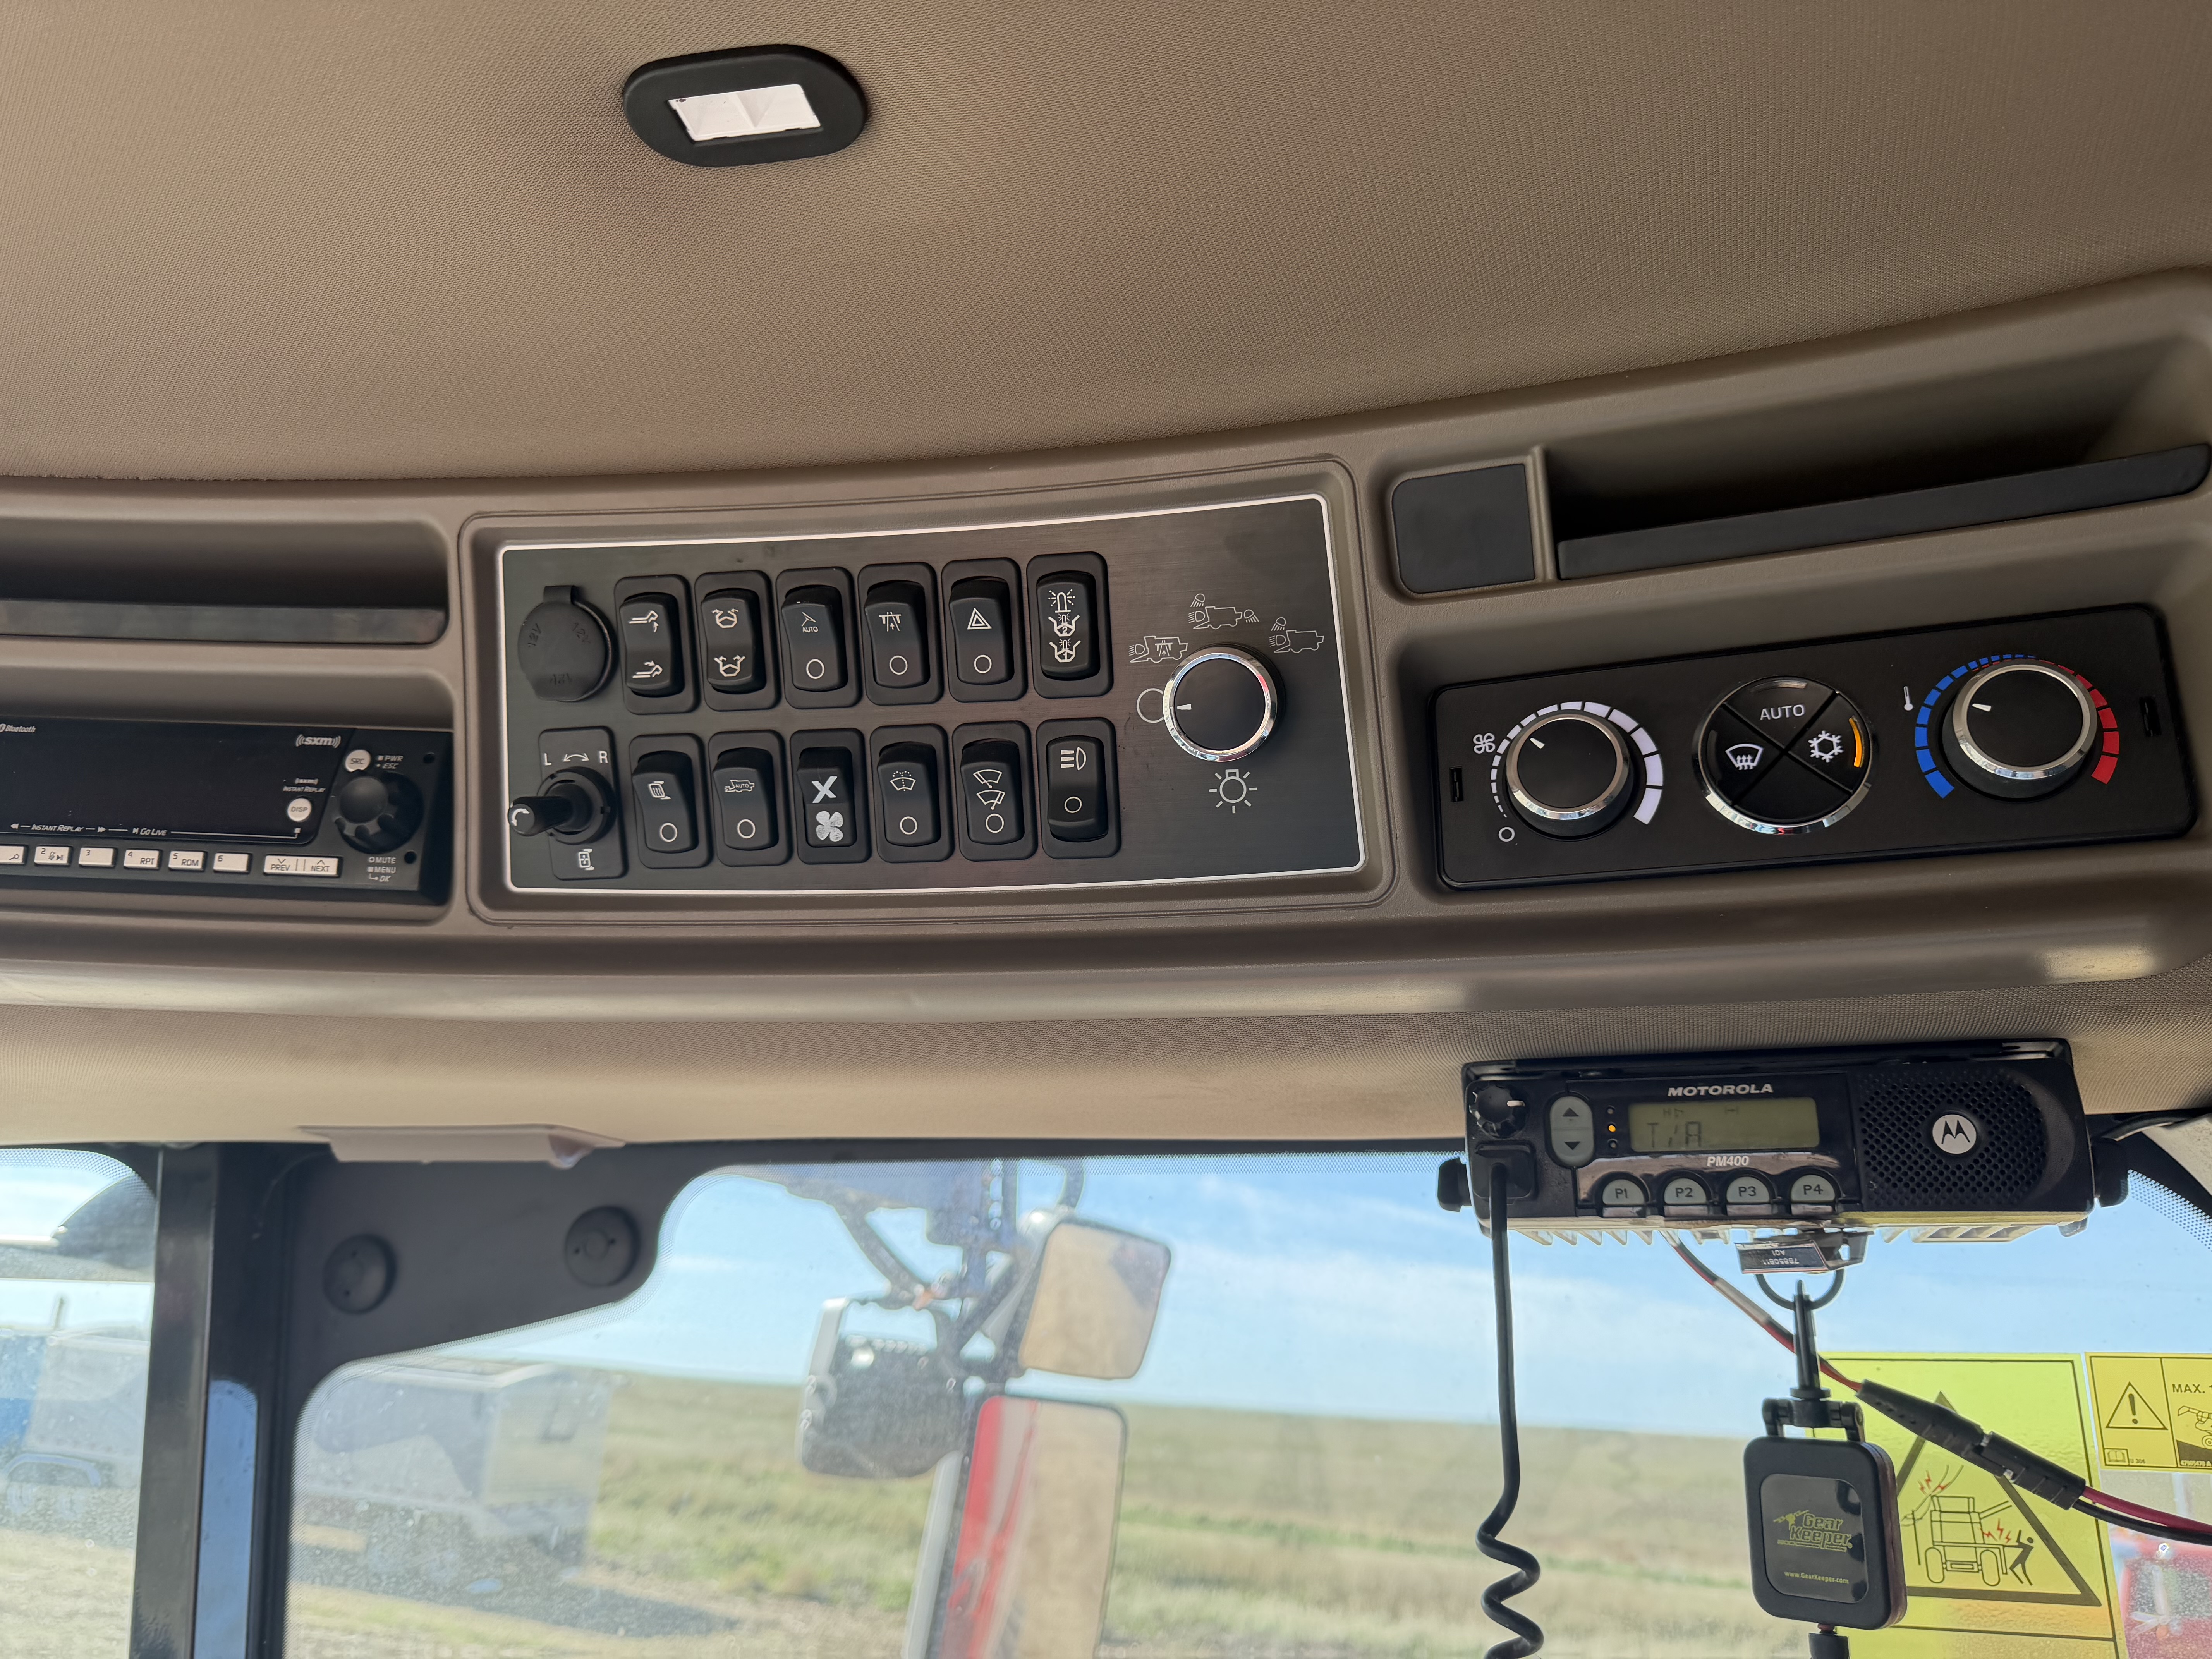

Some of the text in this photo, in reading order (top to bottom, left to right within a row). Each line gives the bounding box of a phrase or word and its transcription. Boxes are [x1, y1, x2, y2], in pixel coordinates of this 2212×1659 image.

[1760, 704, 1805, 721] AUTO
[5, 725, 36, 733] Bluetooth
[544, 750, 608, 766] L R
[1668, 1084, 1774, 1097] MOTOROLA
[1706, 1155, 1750, 1167] PM400
[1614, 1184, 1824, 1199] P1 P2 P3 P4
[2172, 1384, 2205, 1393] MAX.
[1802, 1513, 1844, 1531] Gear
[1784, 1571, 1849, 1584] www.GearKeeper.com
